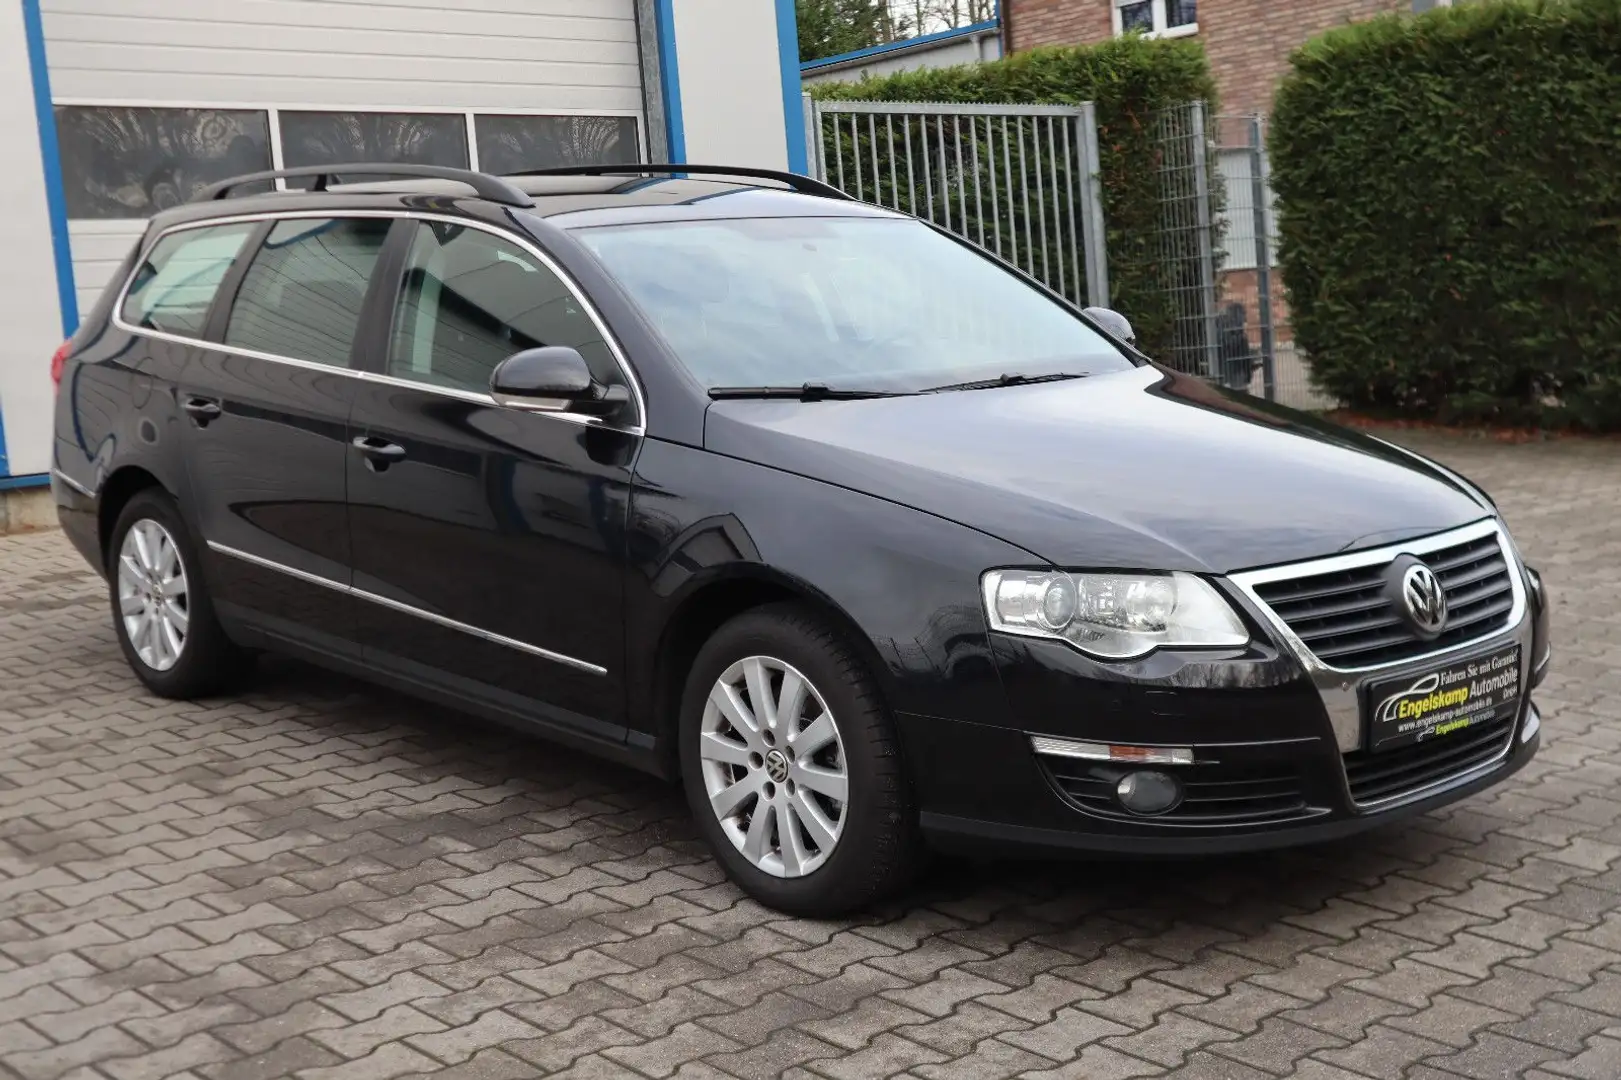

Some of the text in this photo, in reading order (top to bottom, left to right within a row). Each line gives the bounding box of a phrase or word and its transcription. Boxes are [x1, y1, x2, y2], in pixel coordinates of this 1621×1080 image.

[1440, 670, 1466, 685] Fahren
[1467, 664, 1478, 678] Sie
[1479, 660, 1491, 674] mit
[1399, 667, 1518, 719] Engelskamp Automobile
[1436, 717, 1470, 735] Engelskamp
